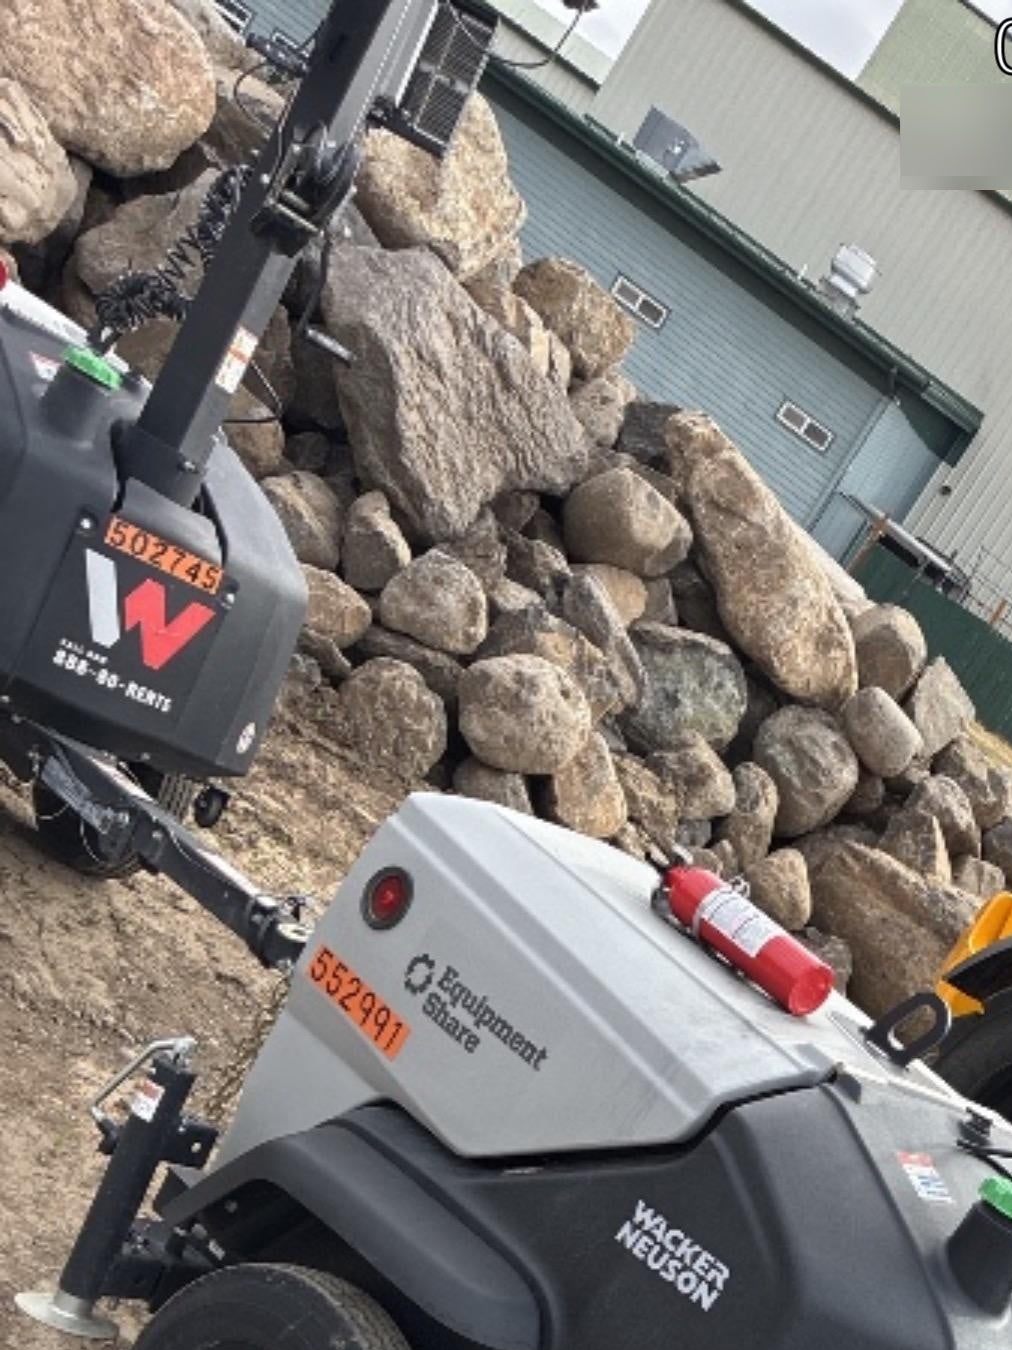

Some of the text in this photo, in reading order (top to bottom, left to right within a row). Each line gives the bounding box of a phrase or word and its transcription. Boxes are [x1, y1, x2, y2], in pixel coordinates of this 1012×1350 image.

[108, 520, 221, 592] 502745
[309, 946, 405, 1052] 552991
[421, 992, 482, 1054] Share
[436, 965, 549, 1071] Equipment
[614, 1220, 721, 1312] NEUSON
[632, 1199, 731, 1291] WACKER
